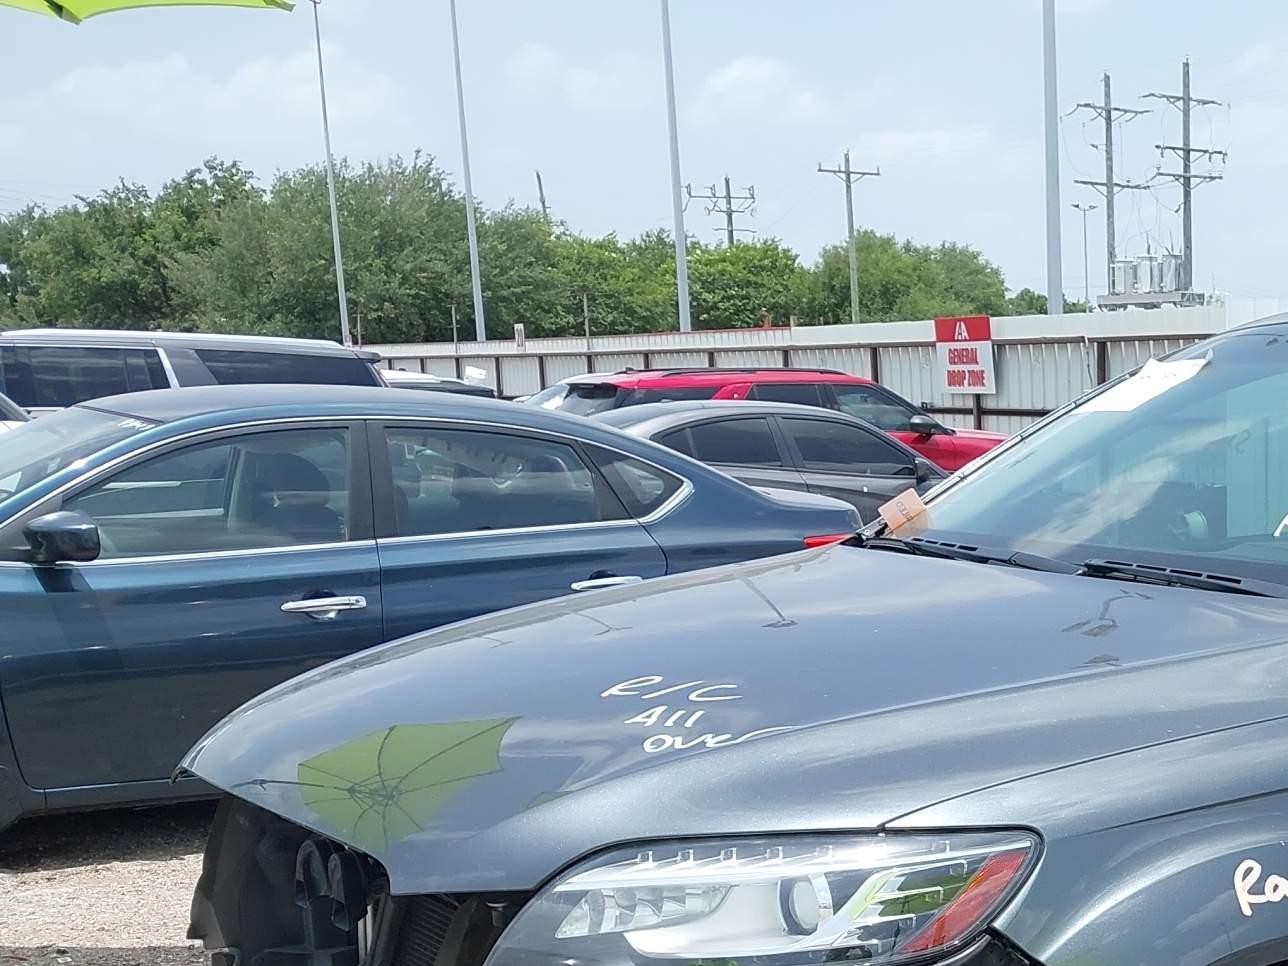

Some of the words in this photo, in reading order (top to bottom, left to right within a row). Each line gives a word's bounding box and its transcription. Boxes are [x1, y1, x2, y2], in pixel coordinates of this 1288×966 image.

[948, 348, 979, 366] GENERAL
[947, 370, 966, 387] DROP
[967, 370, 986, 387] ZONE
